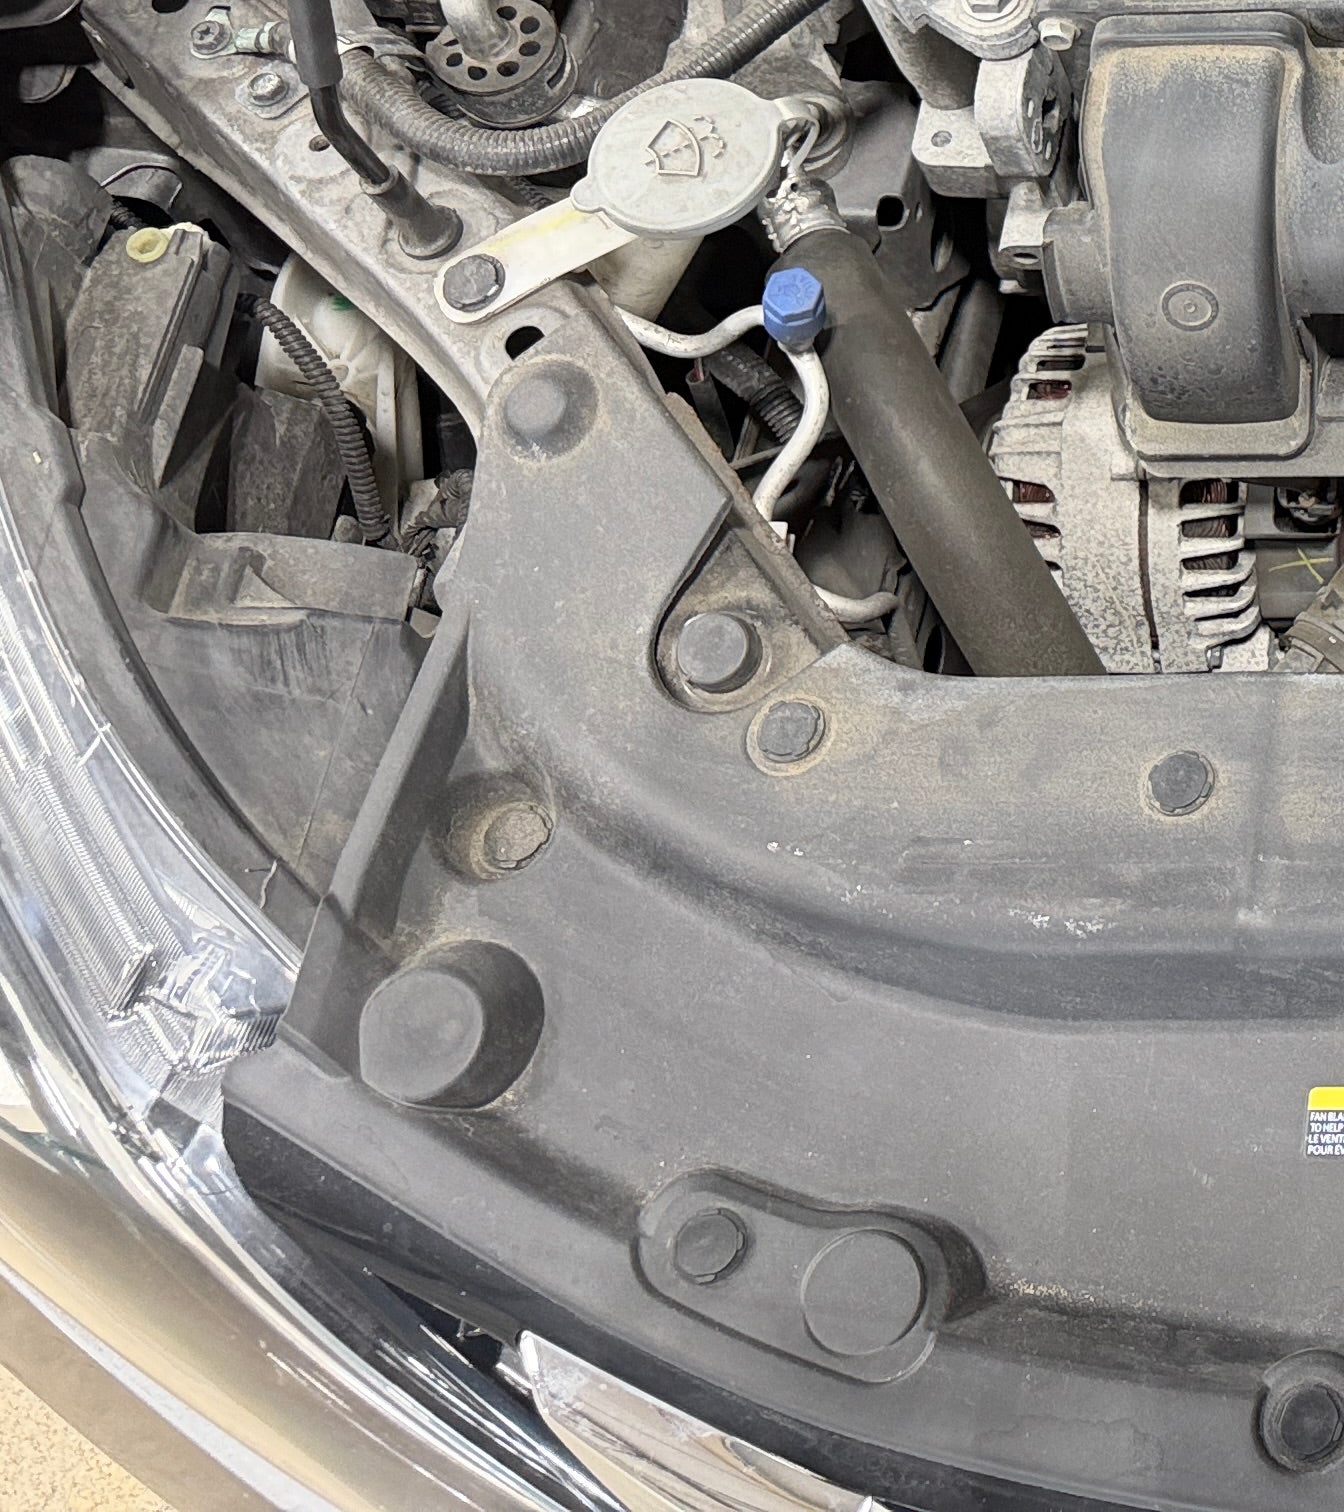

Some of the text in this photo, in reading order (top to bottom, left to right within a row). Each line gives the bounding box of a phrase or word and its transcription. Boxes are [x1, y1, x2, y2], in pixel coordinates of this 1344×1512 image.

[1310, 1111, 1327, 1122] FAN
[1310, 1122, 1321, 1133] TO
[1322, 1122, 1344, 1133] HELP
[1309, 1133, 1319, 1144] LE
[1307, 1144, 1334, 1156] POUR
